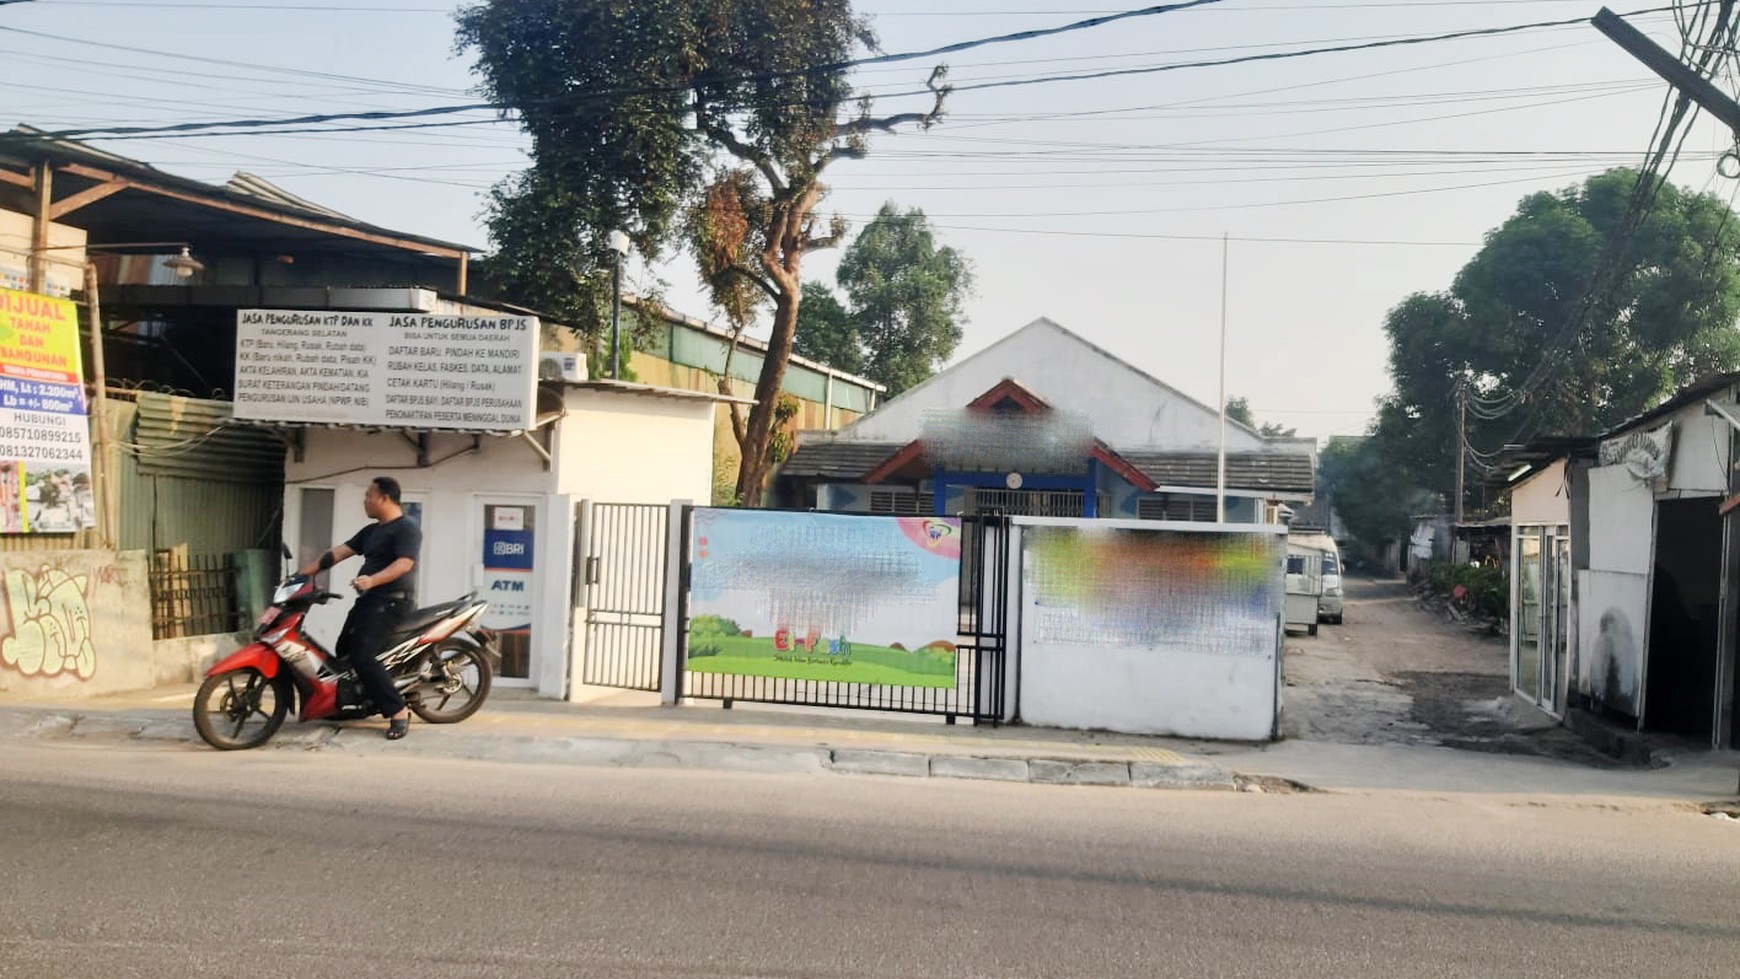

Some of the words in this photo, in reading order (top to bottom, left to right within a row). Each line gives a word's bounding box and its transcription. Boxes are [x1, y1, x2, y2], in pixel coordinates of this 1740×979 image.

[10, 317, 50, 334] TANAH
[242, 312, 263, 324] JASA
[265, 312, 321, 325] PENGURUSAN
[323, 314, 339, 326] KTP
[341, 315, 360, 327] DAN
[361, 316, 373, 327] KK
[389, 315, 417, 328] JASA
[420, 316, 496, 330] PENGURUSAN
[500, 318, 527, 331] BPJS
[261, 328, 310, 337] TANGERANG
[311, 329, 348, 337] SELATAN
[19, 333, 44, 349] DAN
[0, 346, 67, 367] BANGUNAN
[14, 412, 66, 426] HUBUNGI
[0, 426, 82, 443] 085710899215
[0, 445, 83, 460] 081327062344
[506, 542, 524, 555] BRI
[491, 580, 524, 592] ATM
